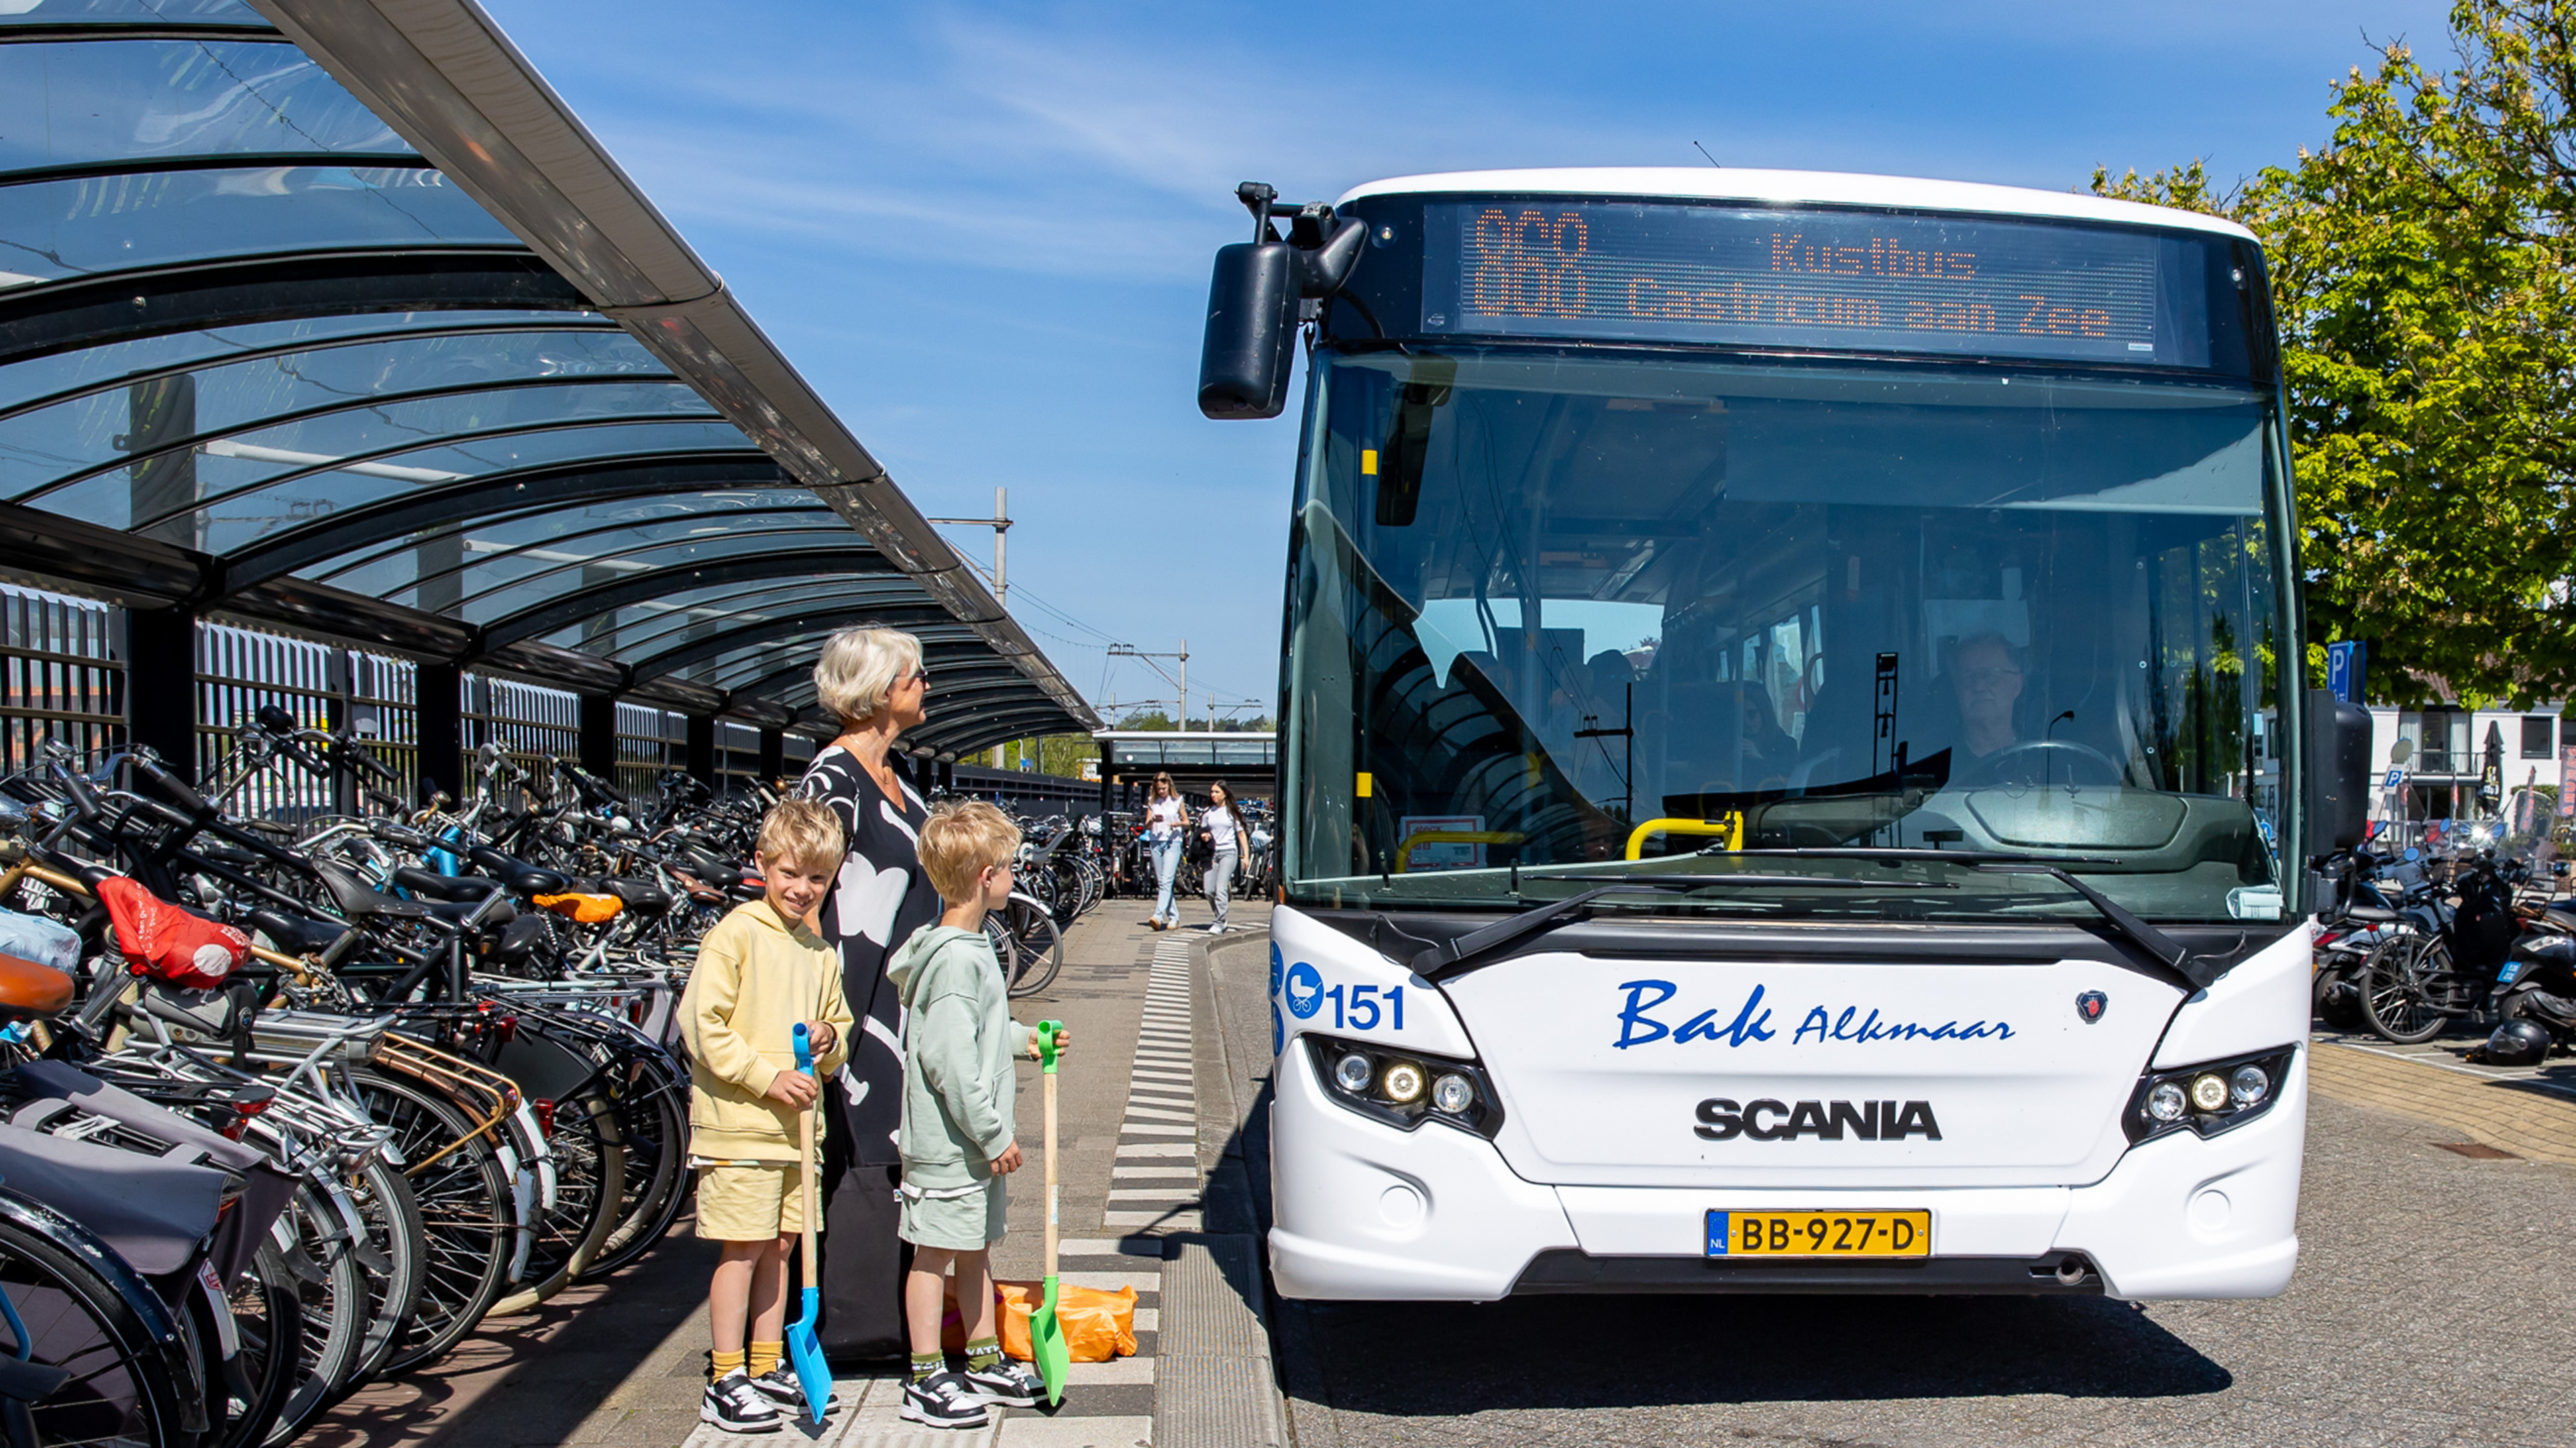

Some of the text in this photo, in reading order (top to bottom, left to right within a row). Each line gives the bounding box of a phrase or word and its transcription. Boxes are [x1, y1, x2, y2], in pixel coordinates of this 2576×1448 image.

[1474, 209, 1588, 319] 868
[1772, 233, 1976, 280] Kustbus
[1627, 278, 2110, 336] Castricum aan Zee
[2332, 649, 2344, 685] P
[2387, 771, 2400, 785] P
[1326, 984, 1403, 1030] 151
[1613, 979, 2016, 1050] Bak Alkmaar
[1693, 1098, 1943, 1141] SCANIA
[1710, 1218, 1915, 1251] NL BB-927-D
